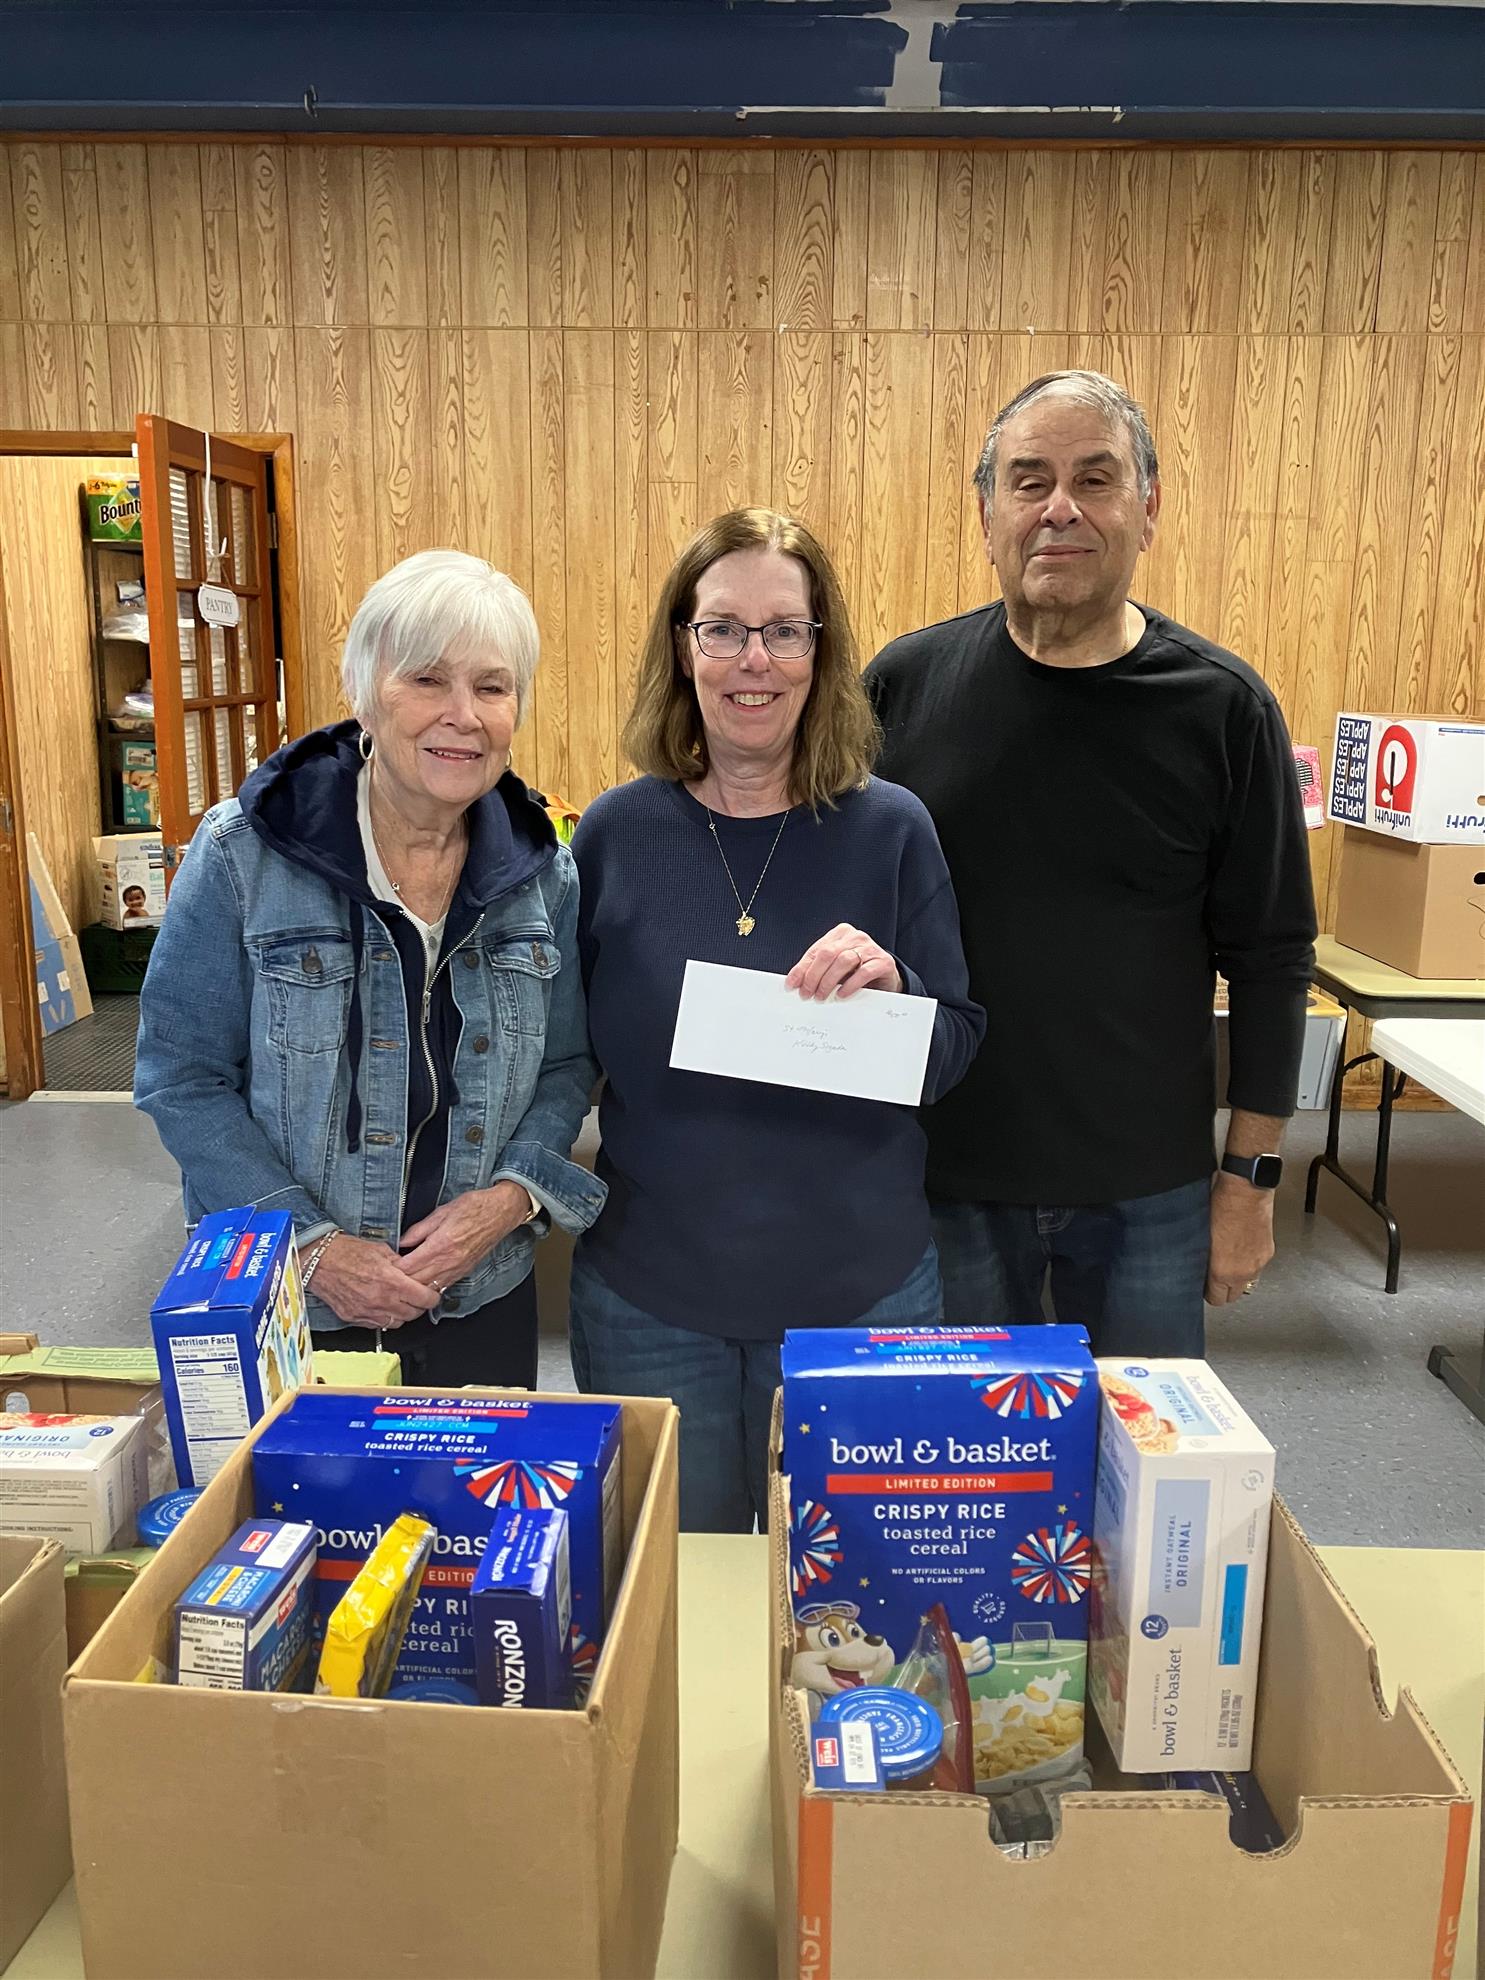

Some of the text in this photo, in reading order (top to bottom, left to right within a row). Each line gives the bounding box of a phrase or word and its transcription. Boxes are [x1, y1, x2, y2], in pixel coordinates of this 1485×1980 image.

[99, 499, 141, 525] Bount
[206, 597, 233, 614] PANTRY
[1340, 719, 1369, 740] APPLES
[1338, 739, 1368, 759] APPES
[1336, 758, 1366, 779] APPES
[1333, 796, 1364, 818] APPLES
[1374, 808, 1411, 830] unifrutti
[1446, 815, 1485, 833] rutti
[171, 1336, 235, 1347] Nutrition Facts
[947, 1354, 978, 1362] RICE
[223, 1363, 239, 1372] 160
[382, 1397, 530, 1409] bowl & basket
[1160, 1383, 1196, 1424] ORIGINAL
[384, 1433, 475, 1443] CRISPY RICE
[365, 1442, 488, 1454] toasted rice cereal
[830, 1436, 1052, 1464] bowl & basket
[886, 1478, 996, 1489] LIMITED EDITION
[873, 1504, 1006, 1520] CRISPY RICE
[883, 1526, 997, 1540] toasted rice
[434, 1527, 490, 1556] bas
[910, 1541, 968, 1555] cereal
[1164, 1515, 1177, 1593] INSTANT OATMEAL
[1176, 1520, 1192, 1588] ORIGINAL
[428, 1572, 475, 1582] EDITIO
[954, 1567, 986, 1575] COLORS
[446, 1600, 468, 1615] RI
[182, 1614, 245, 1630] Nutrition Facts
[1145, 1620, 1159, 1633] 12
[445, 1667, 474, 1675] COLOR
[494, 1619, 525, 1707] RONZON
[1160, 1648, 1182, 1756] bowl & basket
